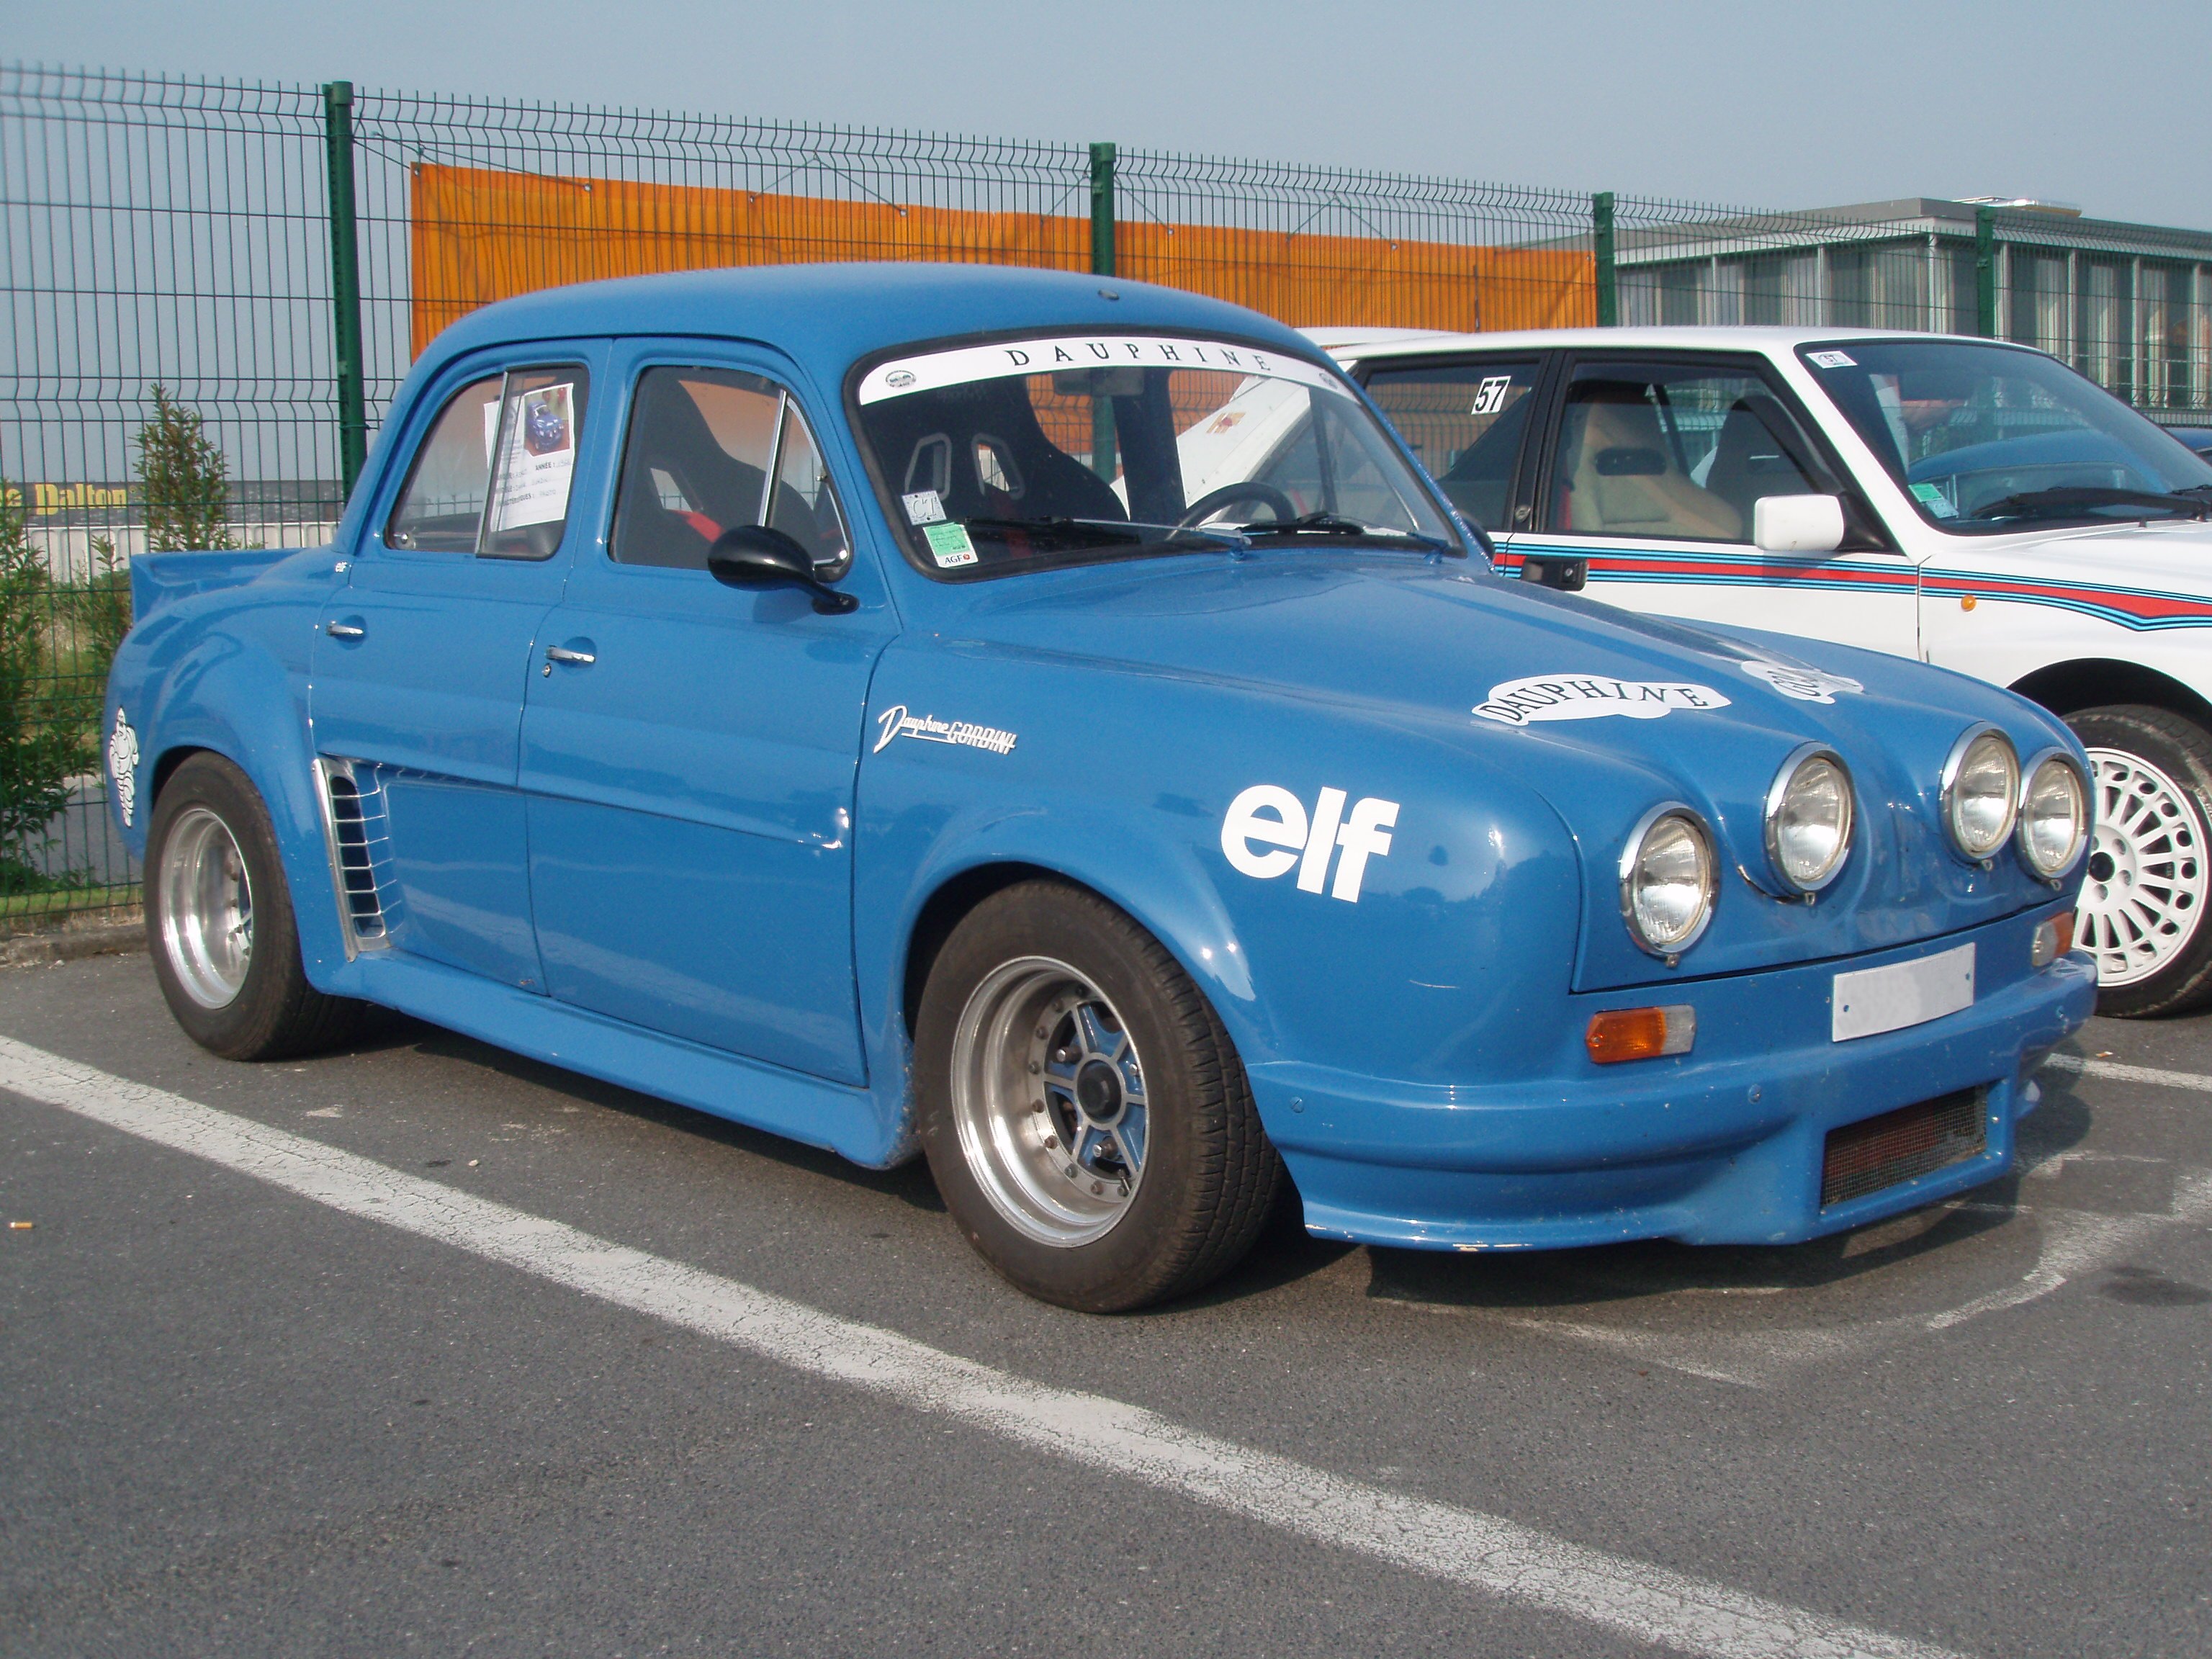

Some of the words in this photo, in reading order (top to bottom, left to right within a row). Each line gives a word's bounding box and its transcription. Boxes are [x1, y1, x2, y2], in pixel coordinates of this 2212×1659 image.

[1005, 343, 1271, 372] DAUPHINE
[1475, 380, 1509, 411] 57
[945, 554, 963, 565] AGF
[1478, 680, 1709, 722] DAUPHINE
[1220, 784, 1401, 904] elf
